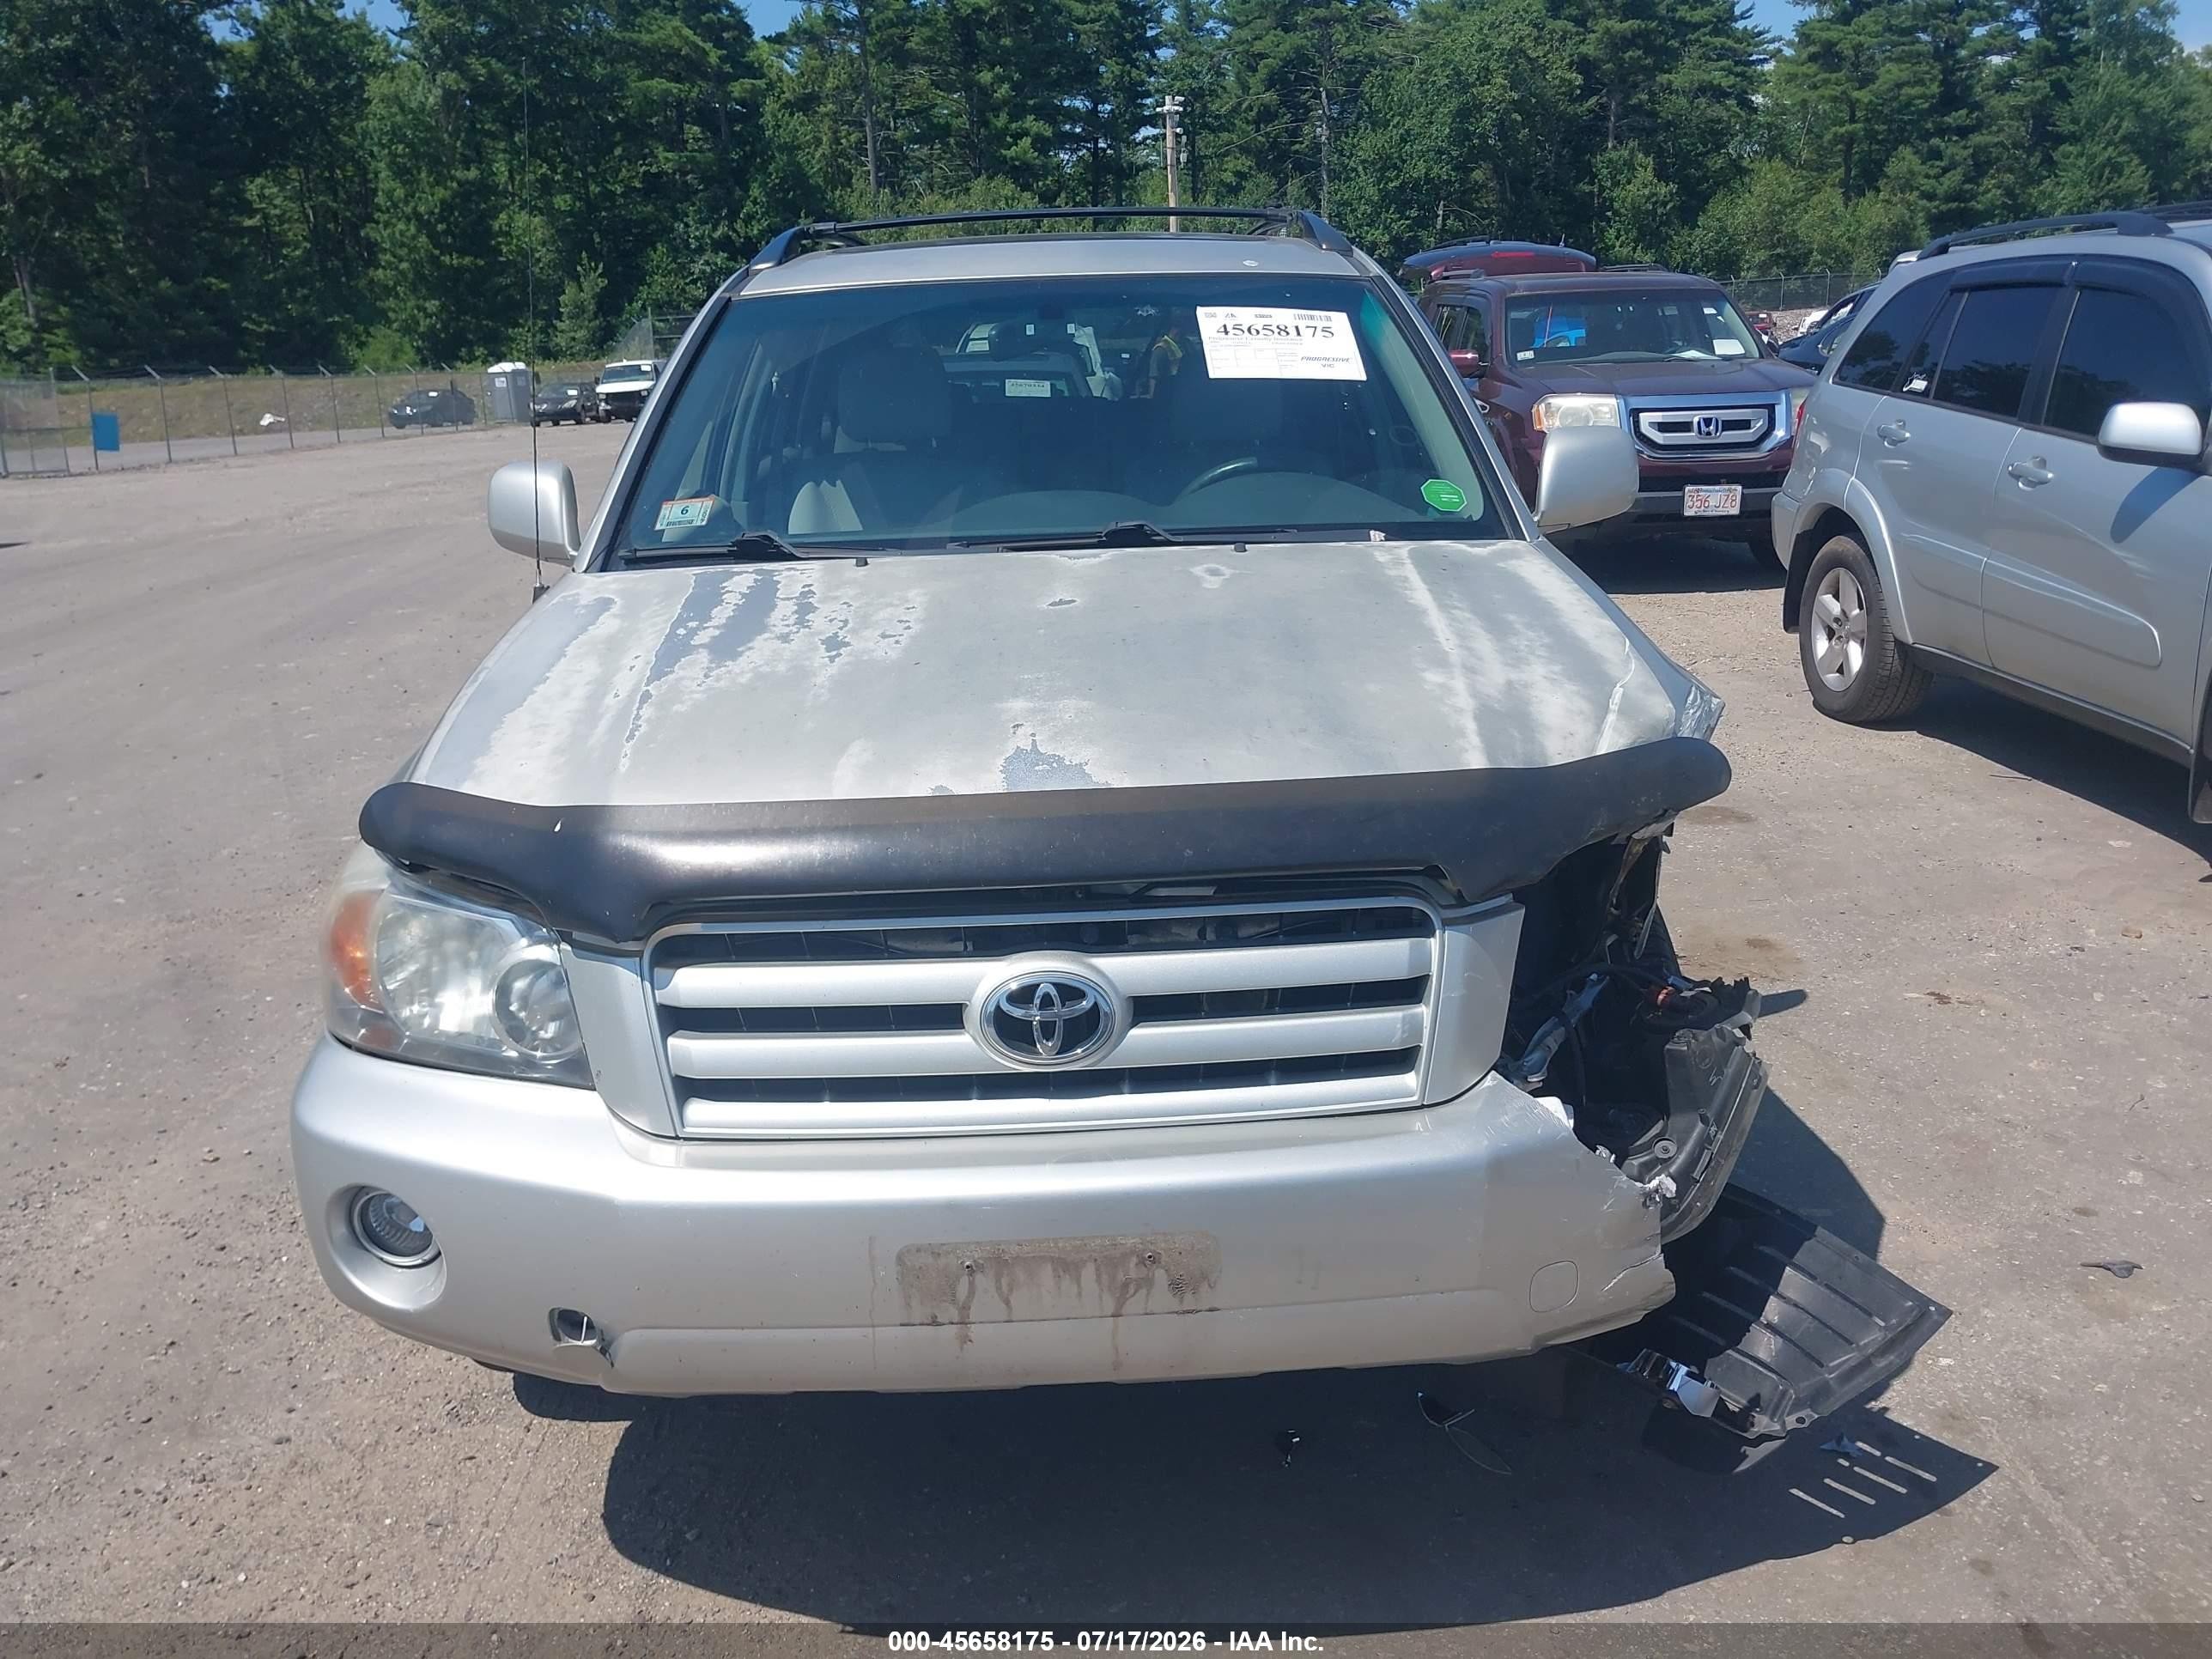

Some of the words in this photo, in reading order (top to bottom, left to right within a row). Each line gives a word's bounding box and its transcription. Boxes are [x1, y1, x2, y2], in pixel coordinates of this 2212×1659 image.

[1216, 323, 1334, 338] 45658175
[1687, 495, 1710, 509] 356
[1715, 494, 1737, 508] JZ8
[681, 506, 690, 515] 6
